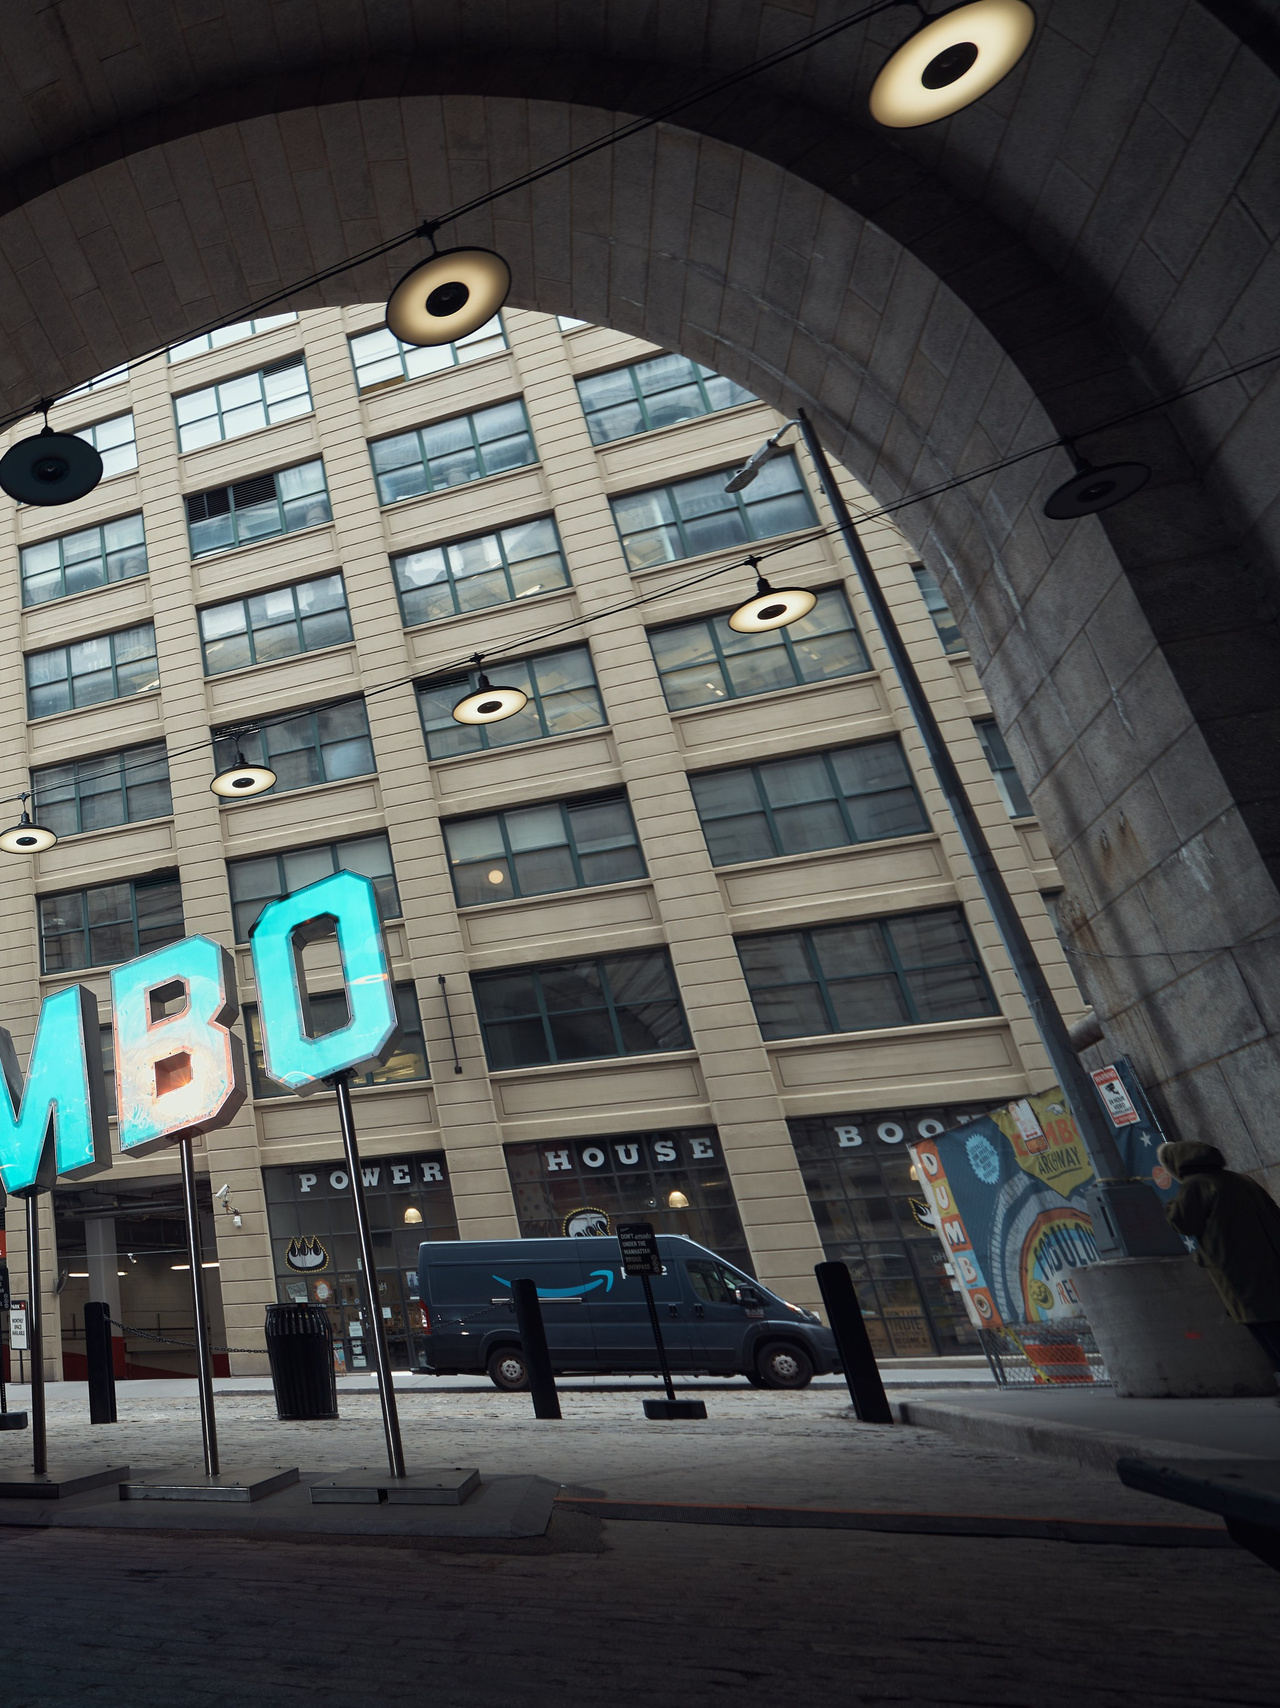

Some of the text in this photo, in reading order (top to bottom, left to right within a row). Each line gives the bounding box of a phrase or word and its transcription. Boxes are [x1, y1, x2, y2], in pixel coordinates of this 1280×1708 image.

[1094, 1069, 1117, 1083] WARNING
[299, 1161, 444, 1193] POWER
[545, 1138, 716, 1171] HOUSE
[833, 1114, 986, 1148] BOO
[1037, 1146, 1081, 1175] ARCHWAY
[921, 1152, 993, 1321] DUMBO
[1033, 1222, 1100, 1281] FABULO
[890, 1318, 923, 1331] INDIE
